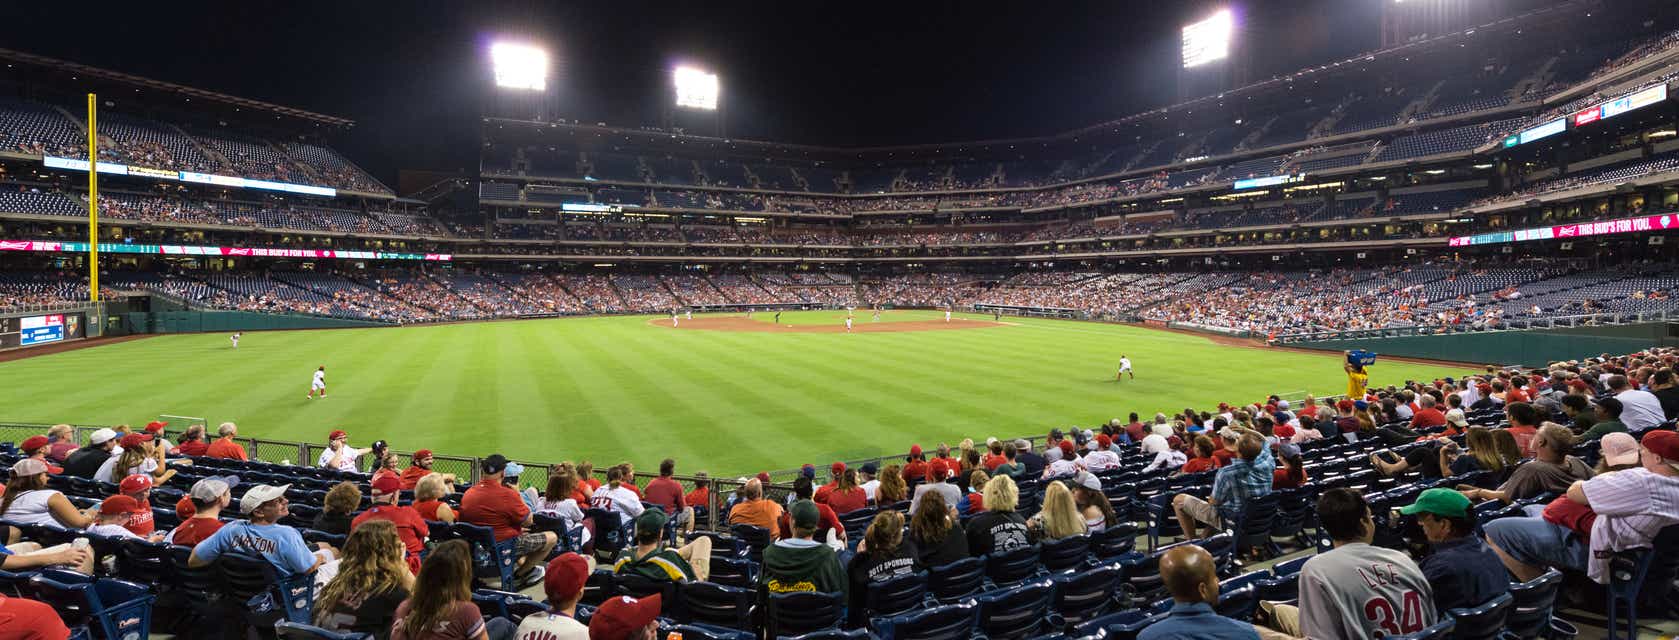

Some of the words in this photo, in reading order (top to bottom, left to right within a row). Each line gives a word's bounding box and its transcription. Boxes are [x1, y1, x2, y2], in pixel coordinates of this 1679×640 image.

[1578, 223, 1593, 236] THIS
[1594, 221, 1615, 234] BUD'S
[1616, 219, 1631, 232] FOR
[1632, 217, 1651, 231] YOU.
[251, 248, 267, 256] THIS
[289, 249, 302, 257] FOR
[230, 535, 276, 554] CATON
[868, 564, 883, 578] 2017
[1354, 561, 1399, 589] LEE
[1363, 589, 1425, 639] 34
